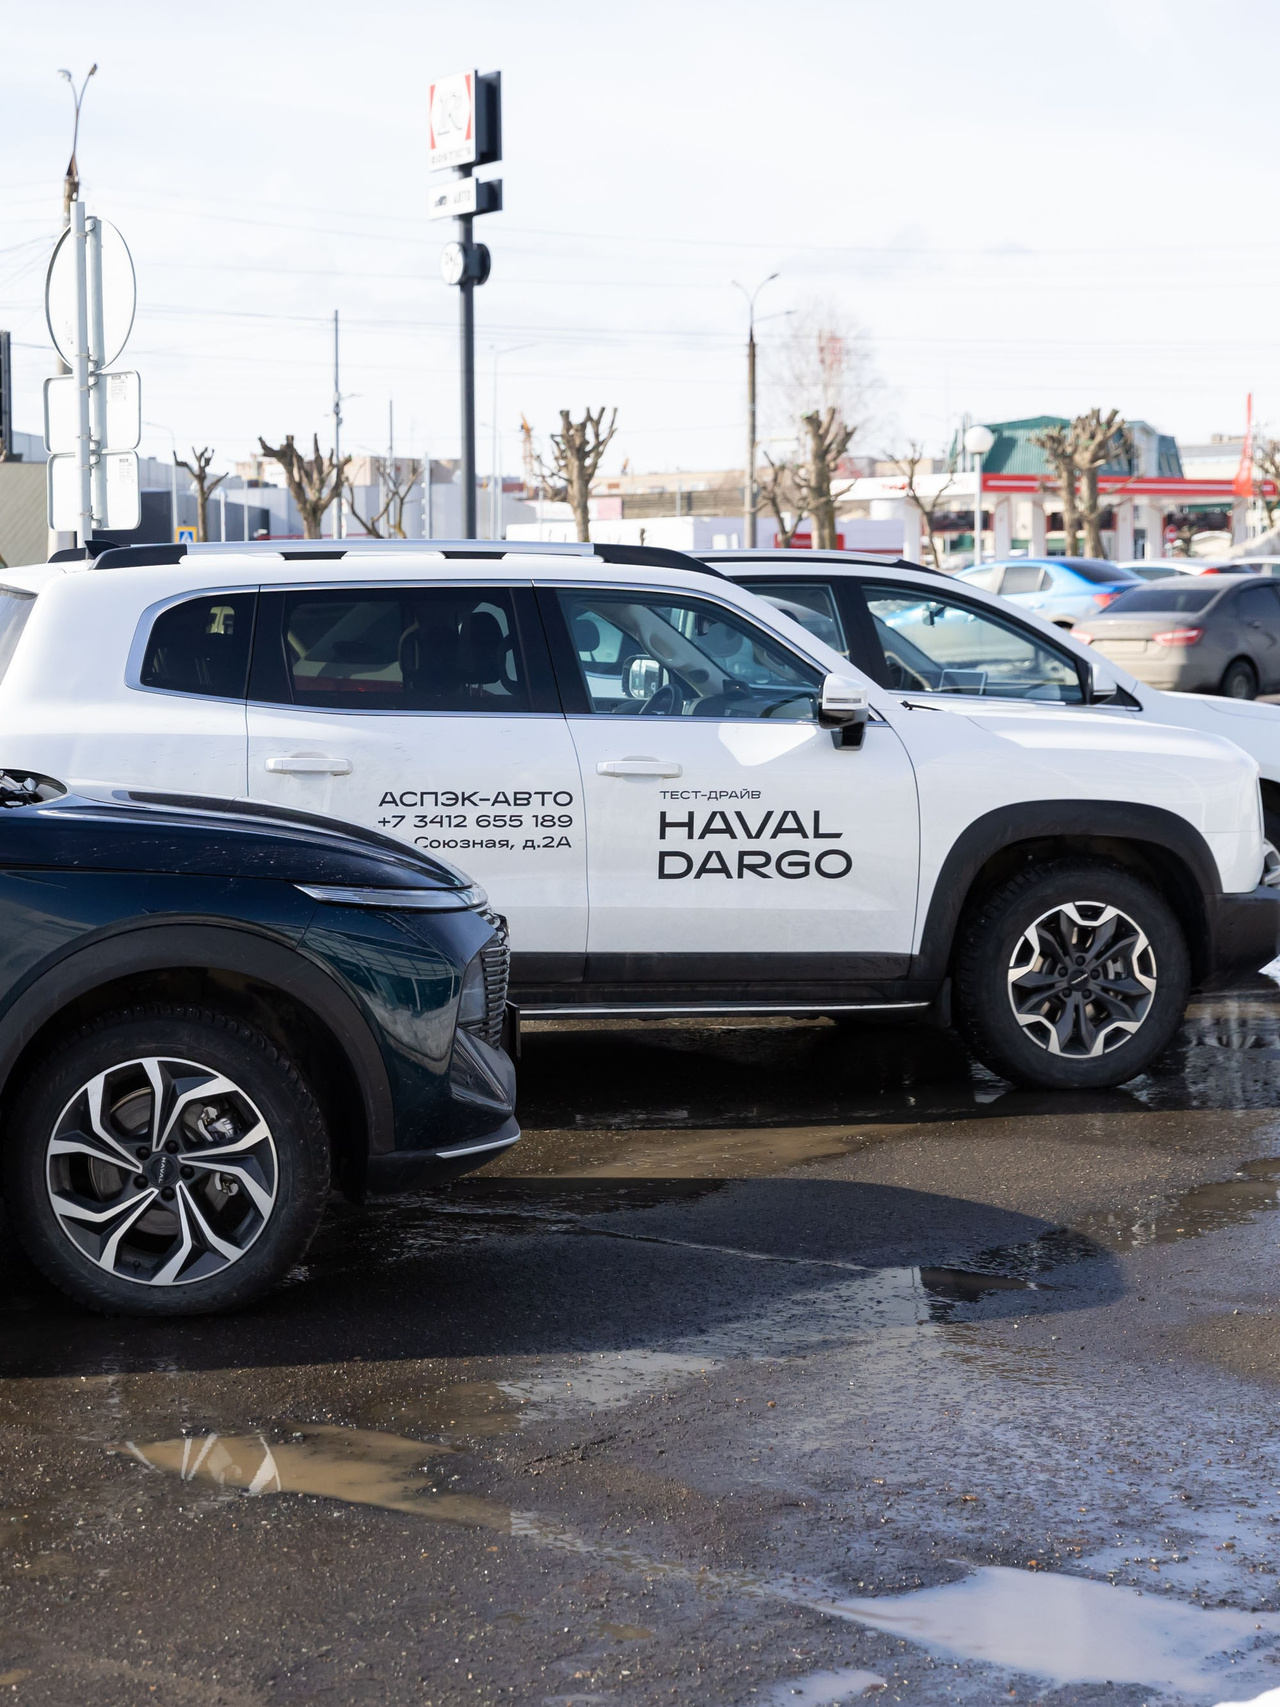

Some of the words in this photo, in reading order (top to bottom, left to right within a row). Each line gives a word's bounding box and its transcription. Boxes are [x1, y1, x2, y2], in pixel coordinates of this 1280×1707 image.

[378, 791, 574, 807] АСПЭК-АВТО
[659, 789, 761, 801] ТЕСТ-ДРАЙВ
[378, 815, 405, 828] +7
[413, 815, 467, 828] 3412
[476, 815, 523, 828] 655
[532, 814, 573, 828] 189
[659, 810, 843, 840] HAVAL
[414, 836, 515, 850] Союзная,
[522, 836, 572, 850] д.2А
[658, 849, 853, 879] DARGO
[158, 1156, 166, 1184] HAVAL
